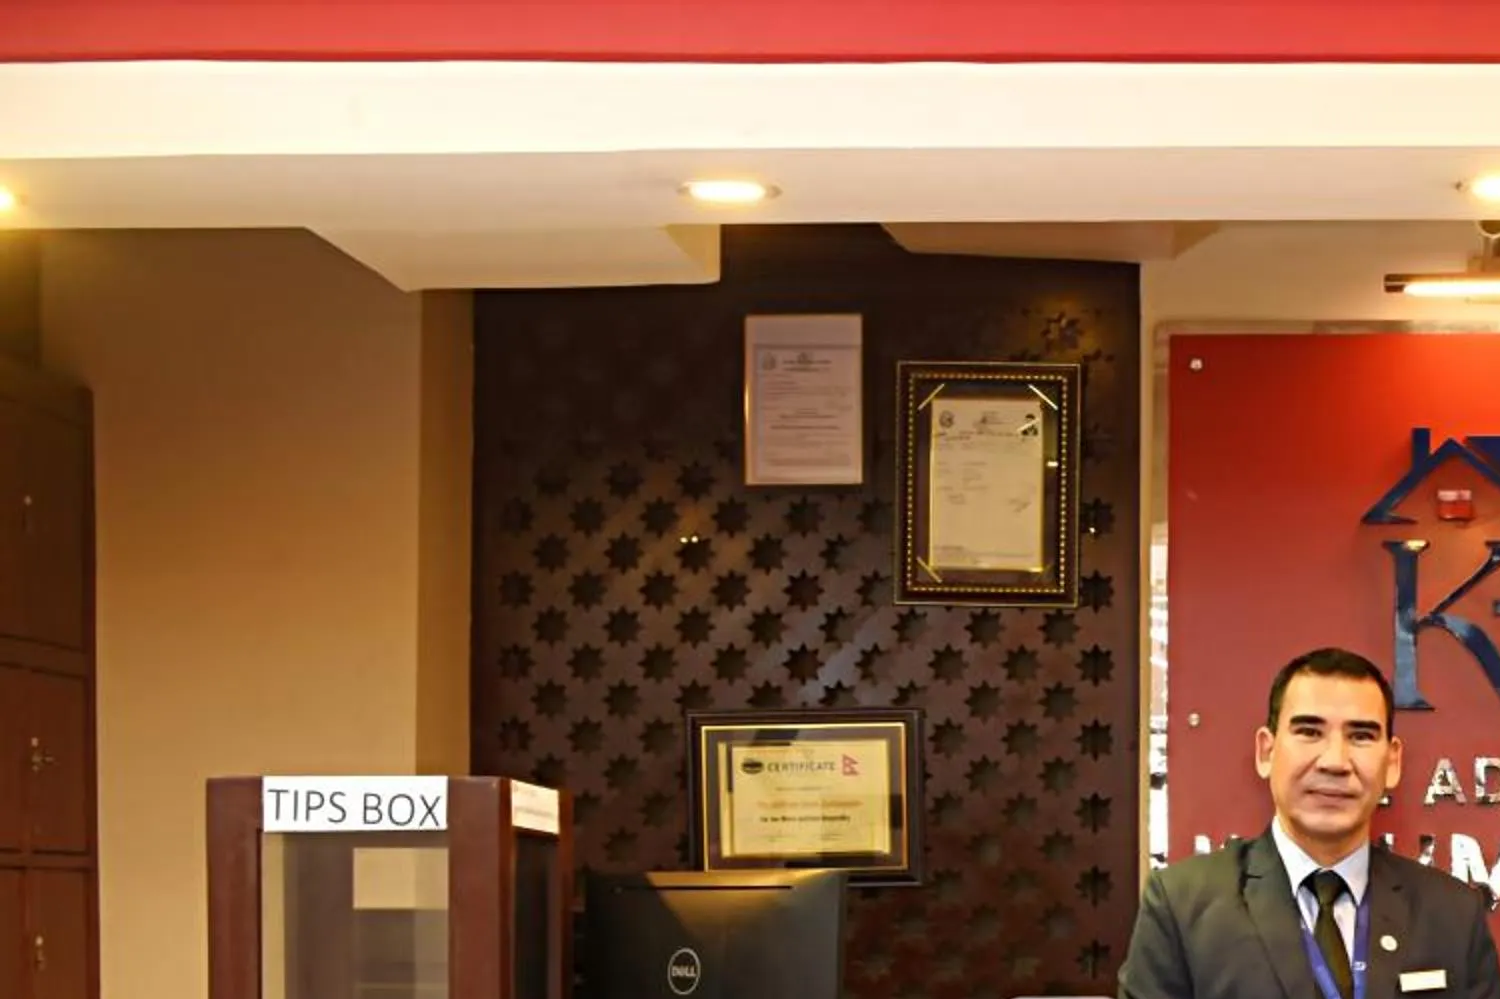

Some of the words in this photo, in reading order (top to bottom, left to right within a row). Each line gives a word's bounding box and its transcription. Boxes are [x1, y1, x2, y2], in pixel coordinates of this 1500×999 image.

[766, 760, 837, 774] CERTIFICATE
[267, 788, 348, 824] TIPS
[362, 792, 442, 828] BOX
[671, 964, 697, 977] DELL
